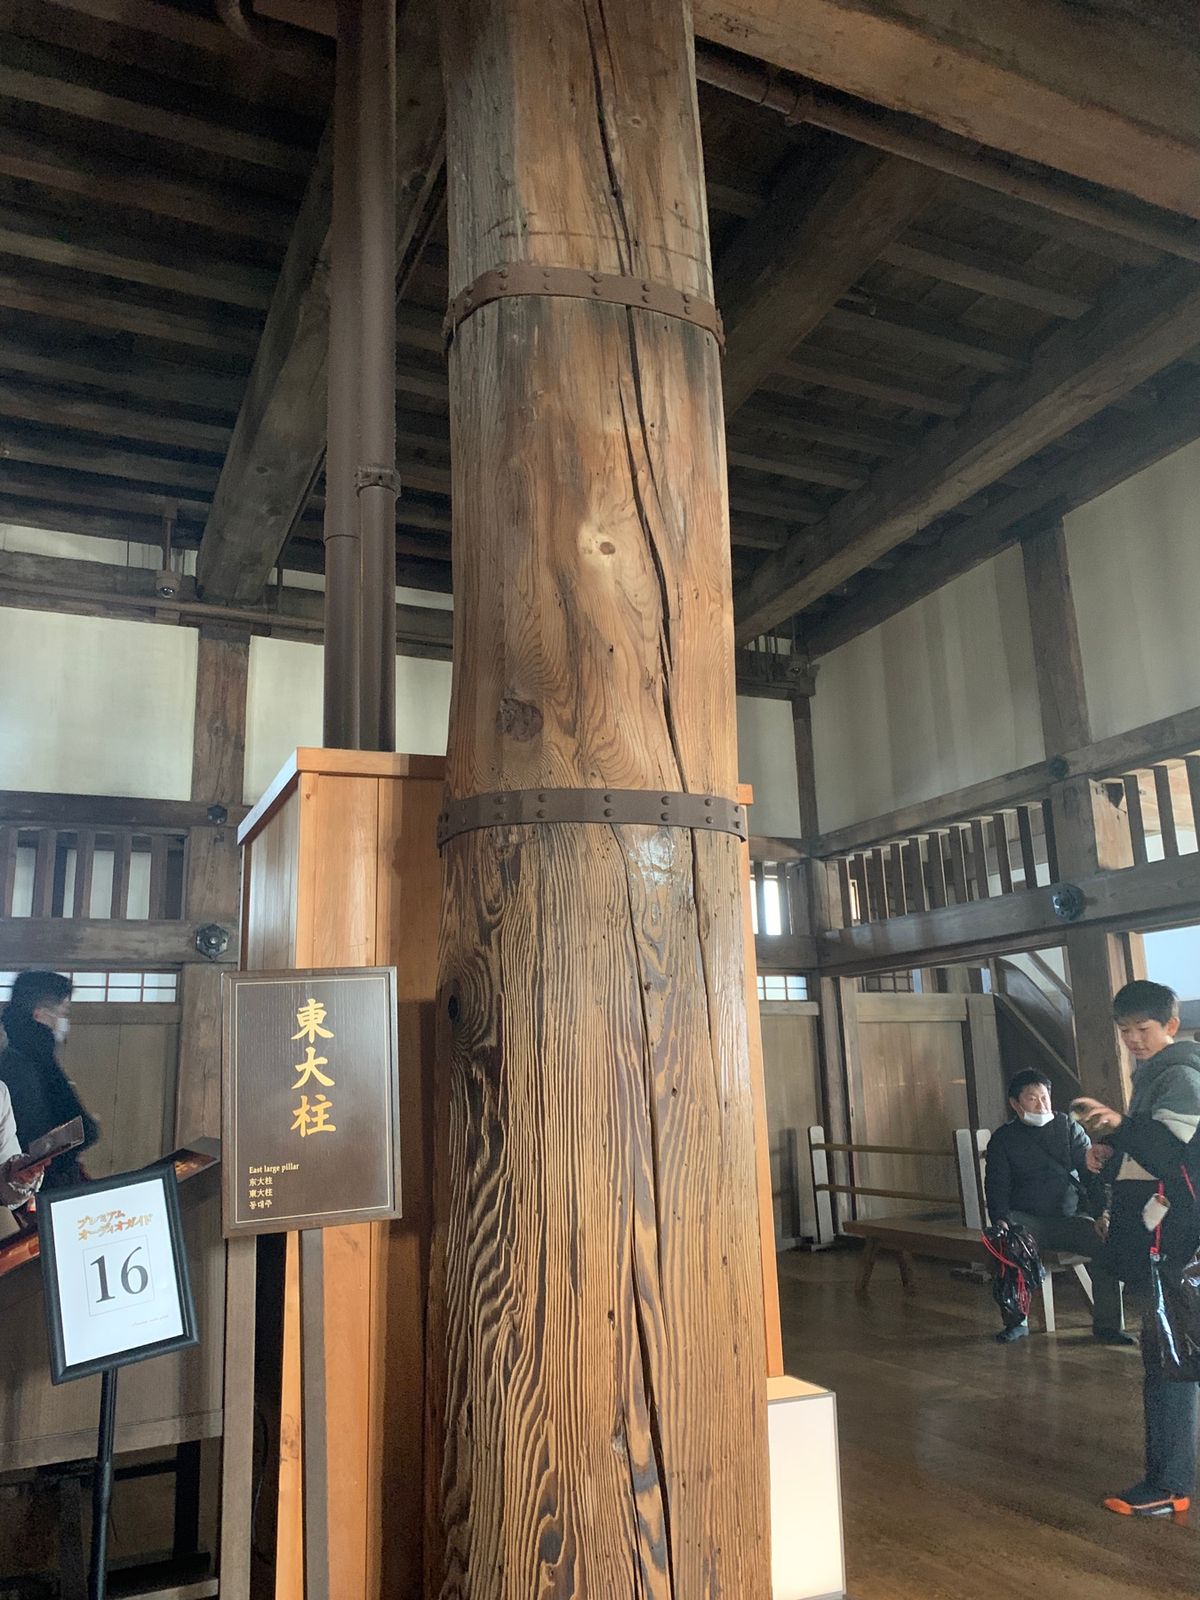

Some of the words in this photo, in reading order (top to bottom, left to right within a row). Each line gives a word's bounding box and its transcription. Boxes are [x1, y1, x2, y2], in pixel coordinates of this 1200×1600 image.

[290, 998, 337, 1137] 東大柱
[249, 1166, 263, 1174] East
[264, 1165, 280, 1174] large
[281, 1163, 299, 1173] pillar
[249, 1188, 273, 1198] 東大柱
[90, 1246, 148, 1303] 16
